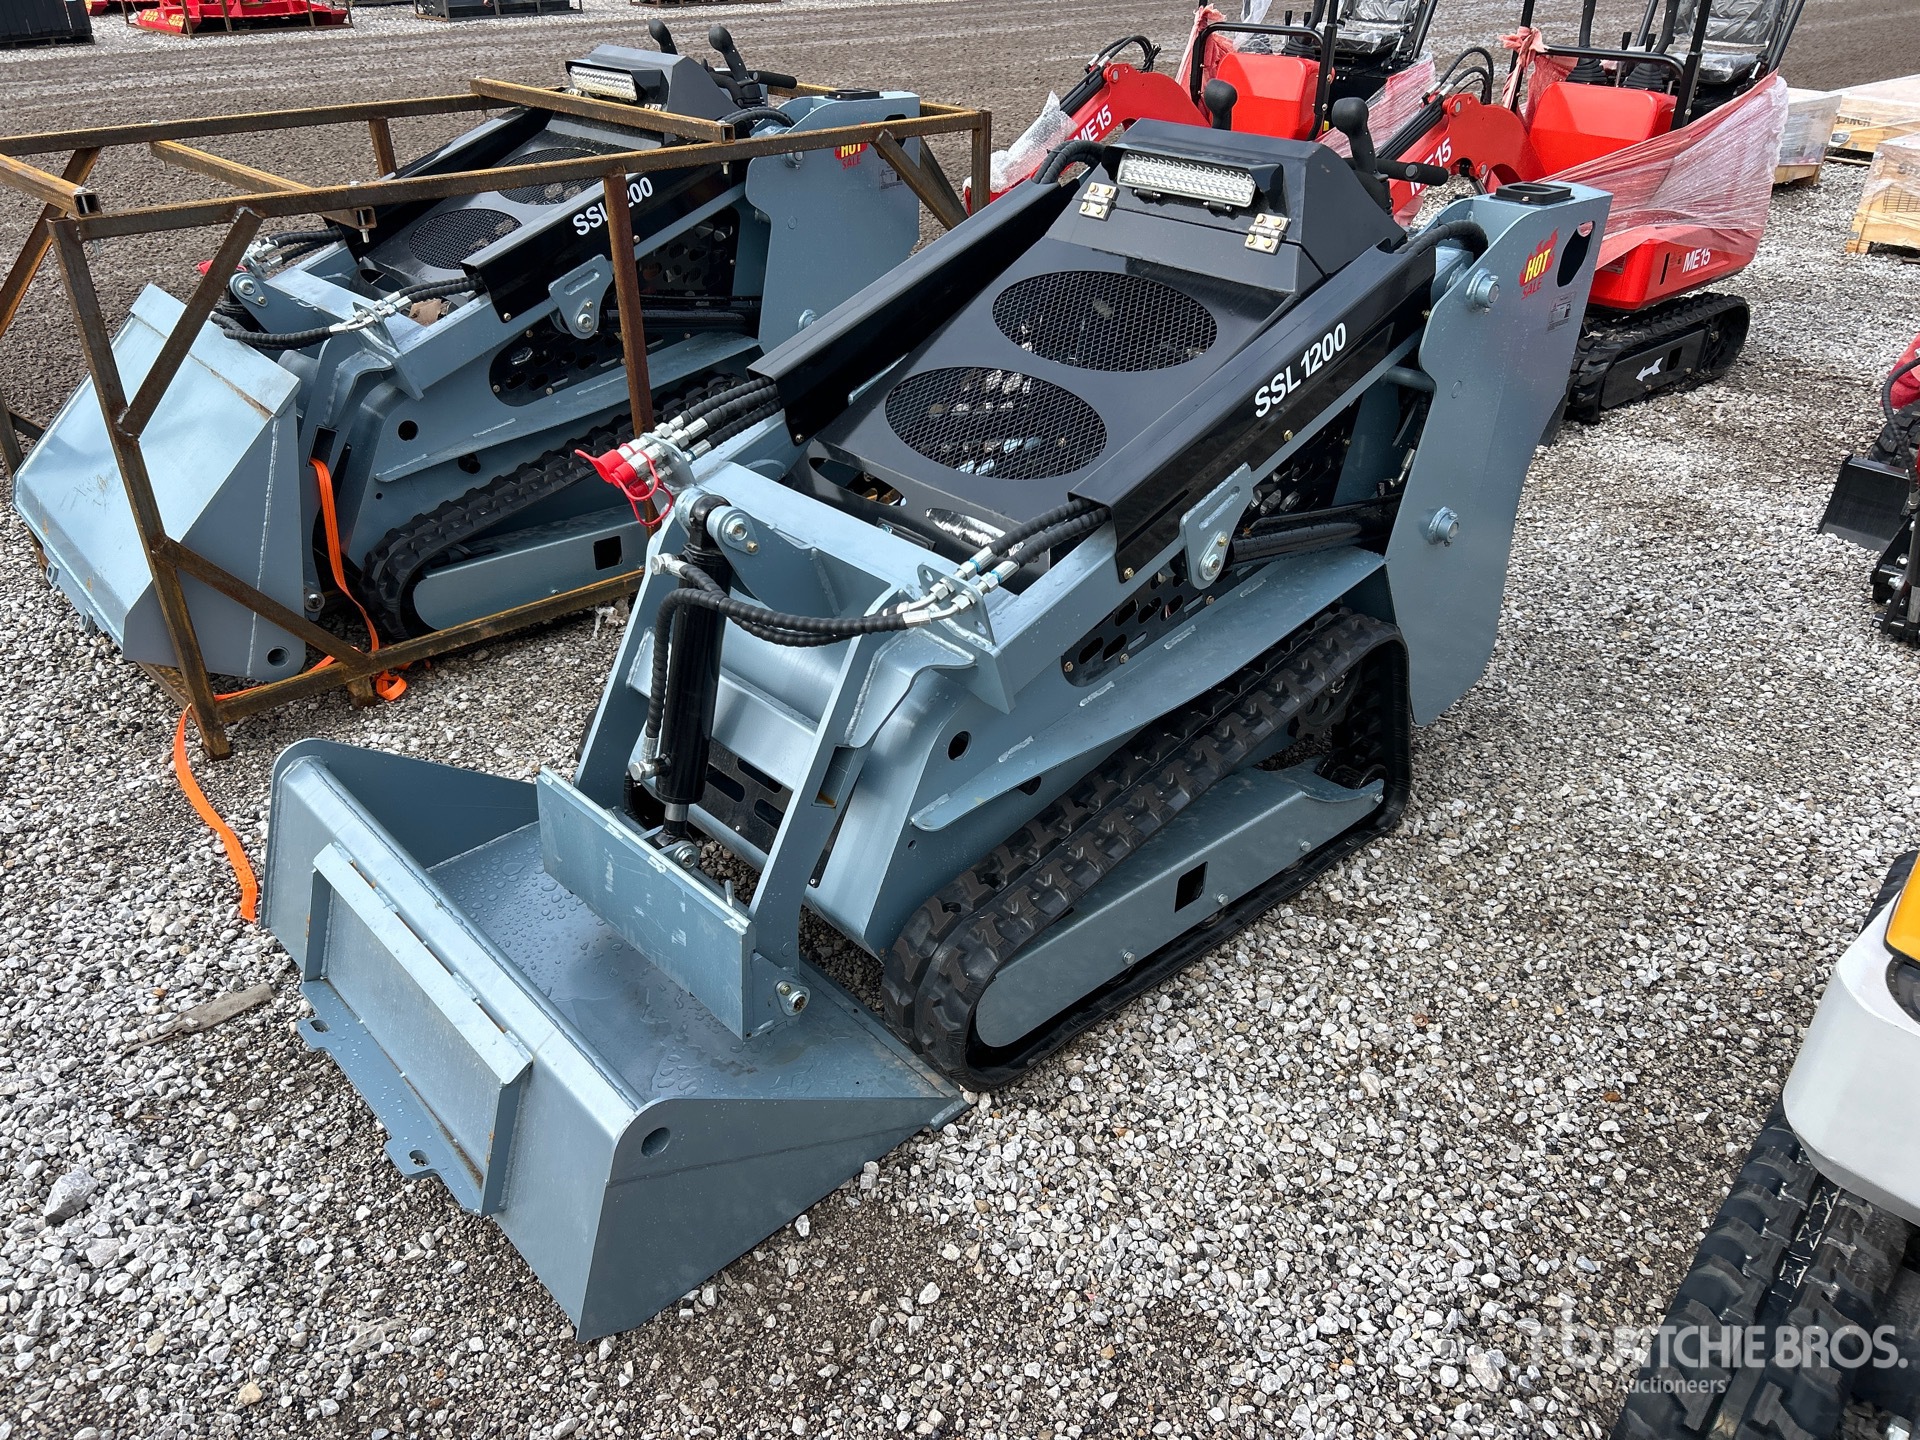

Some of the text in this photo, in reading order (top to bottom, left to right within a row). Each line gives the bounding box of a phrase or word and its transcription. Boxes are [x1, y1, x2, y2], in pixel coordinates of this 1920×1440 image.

[842, 155, 862, 171] SALE
[1524, 248, 1551, 284] HOT
[1520, 276, 1543, 301] SALE
[1254, 322, 1347, 418] SSL 1200
